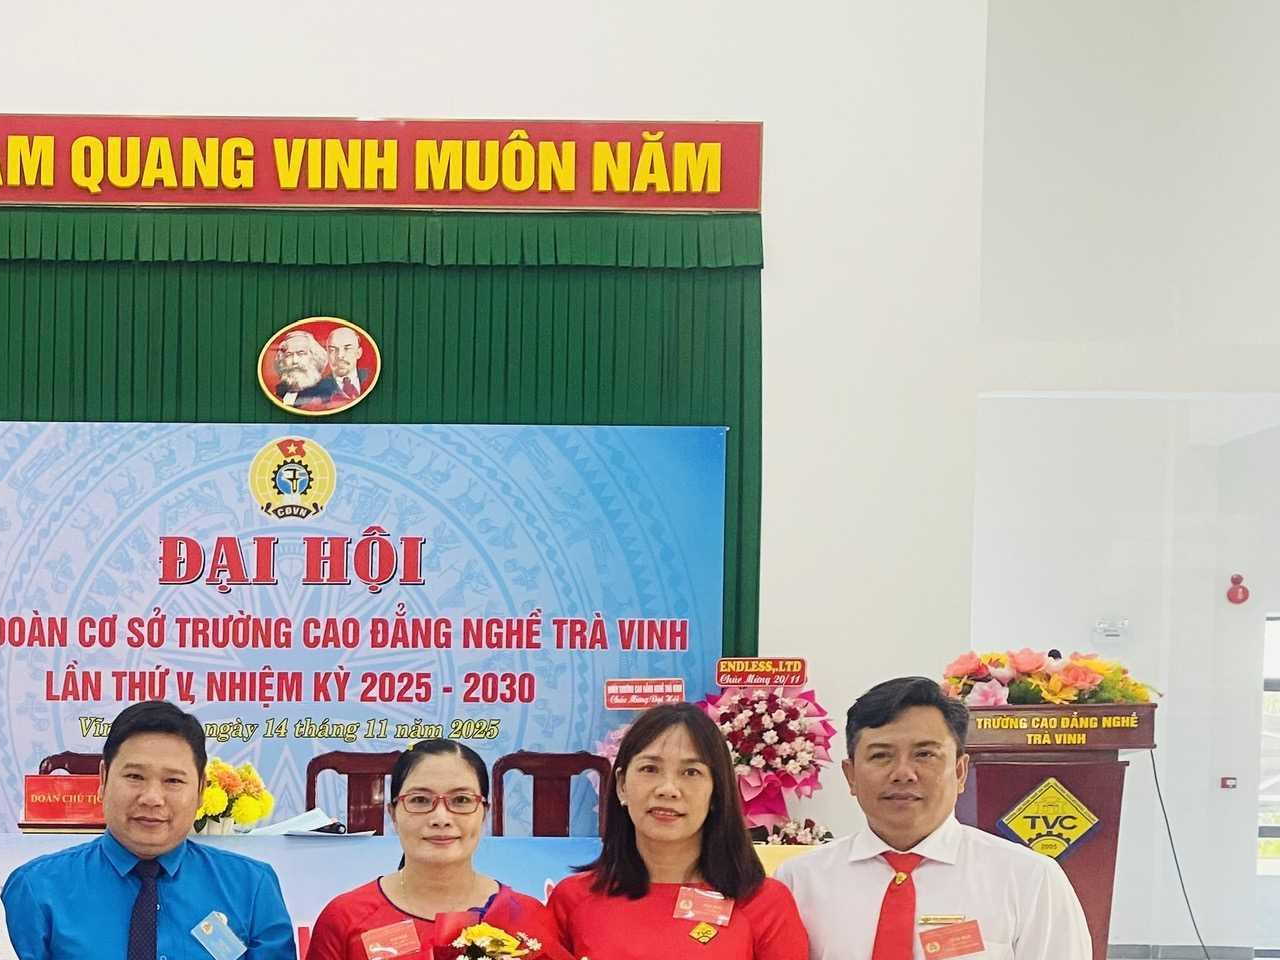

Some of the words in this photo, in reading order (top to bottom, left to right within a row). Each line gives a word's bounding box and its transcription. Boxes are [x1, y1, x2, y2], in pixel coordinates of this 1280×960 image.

[71, 135, 254, 194] QUANG
[274, 137, 398, 192] VINH
[414, 129, 577, 193] MUÔN
[591, 131, 722, 195] NĂM
[159, 535, 279, 593] ĐẠI
[302, 525, 427, 593] HỘI
[78, 613, 119, 648] CƠ
[126, 606, 167, 649] SỞ
[175, 609, 292, 649] TRƯỜNG
[302, 616, 361, 649] CAO
[370, 602, 452, 649] ĐẲNG
[462, 607, 542, 650] NGHỀ
[552, 612, 609, 651] TRÀ
[618, 619, 689, 651] VINH
[44, 659, 102, 702] LẦN
[111, 667, 171, 702] THỨ
[175, 671, 196, 706] V,
[207, 665, 303, 708] NHIỆM
[313, 665, 352, 702] KỲ
[360, 671, 433, 703] 2025
[463, 671, 536, 703] 2030
[263, 718, 289, 738] 14
[294, 717, 360, 742] tháng
[364, 719, 390, 739] 11
[394, 719, 443, 739] năm
[448, 719, 500, 739] 2025
[976, 714, 1028, 729] TRƯỜNG
[1031, 717, 1058, 729] CAO
[1026, 731, 1052, 745] TRÀ
[1055, 732, 1087, 744] VINH
[1023, 815, 1078, 830] TVC
